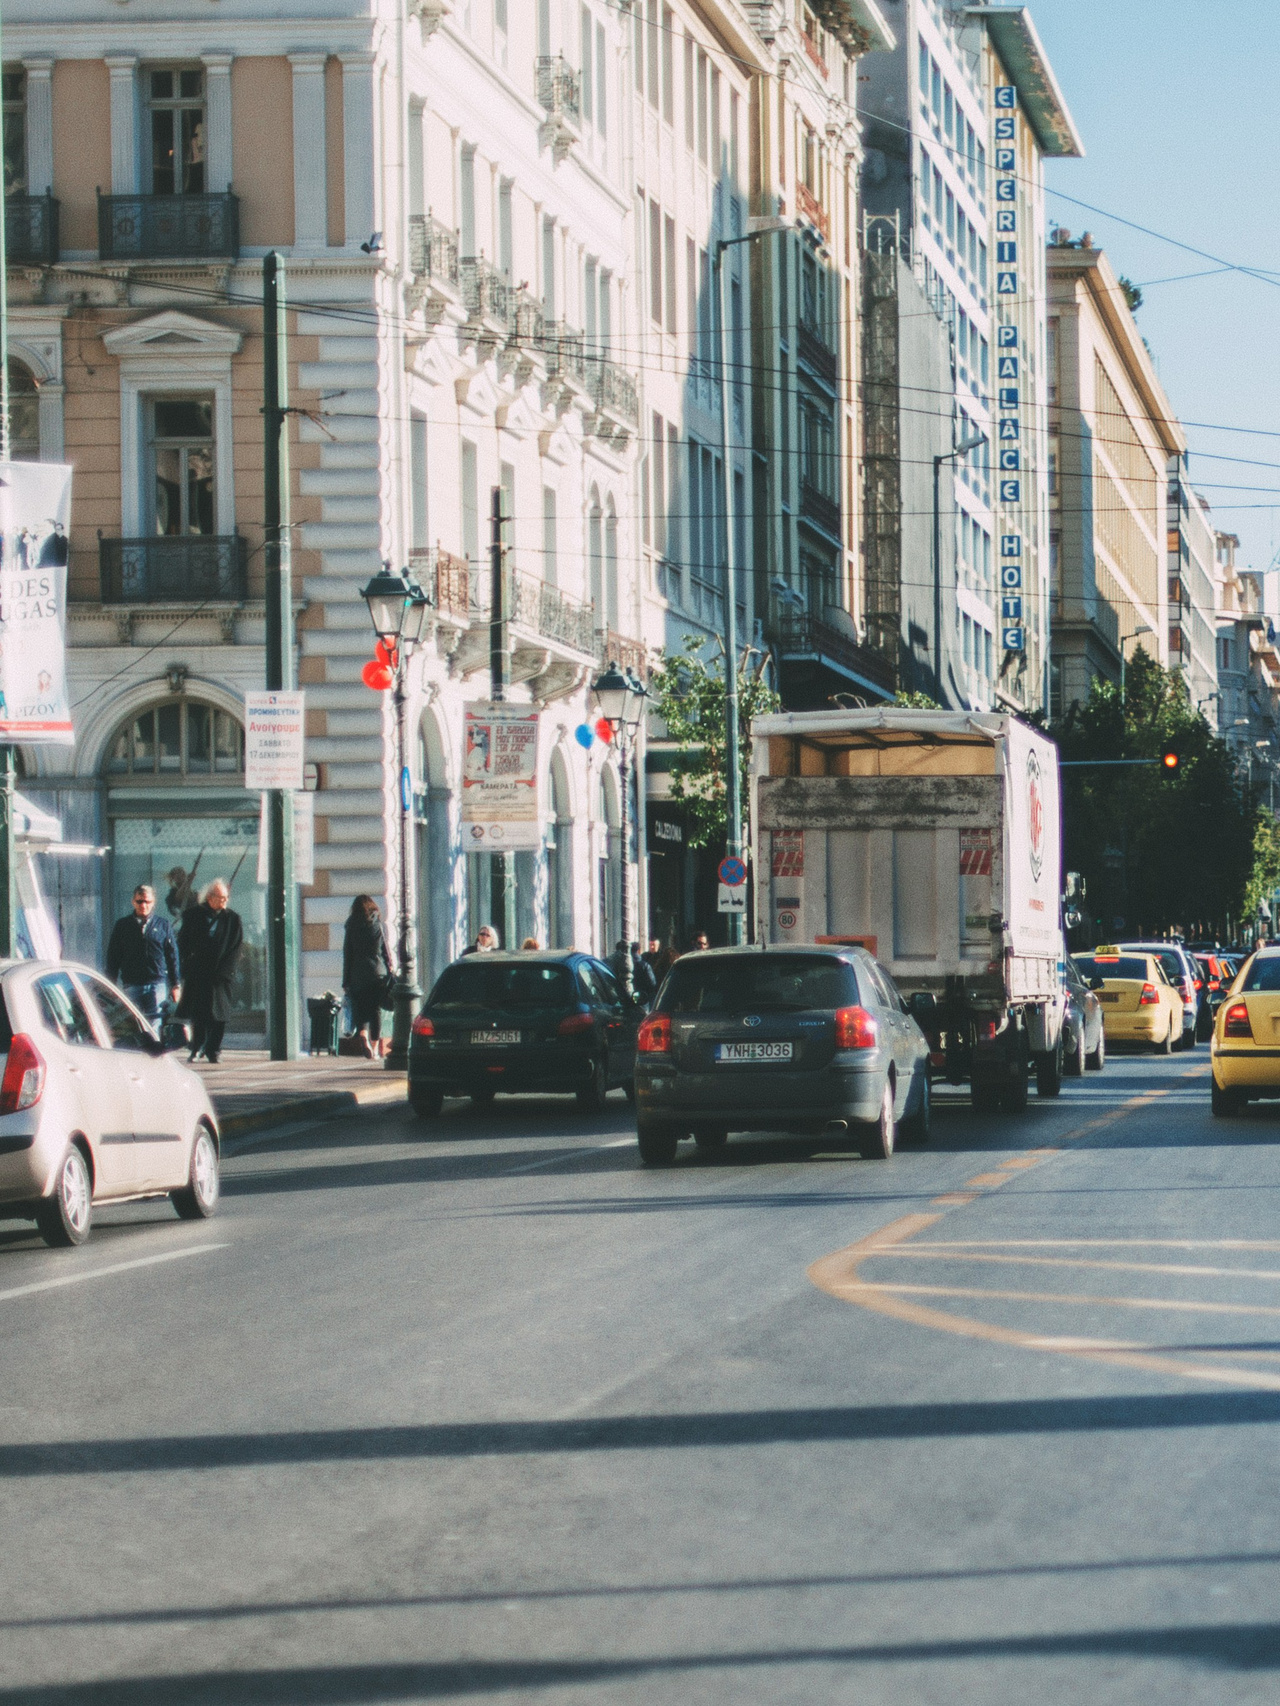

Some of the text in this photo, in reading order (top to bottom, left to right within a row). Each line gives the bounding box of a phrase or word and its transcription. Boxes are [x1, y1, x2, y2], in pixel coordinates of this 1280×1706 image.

[997, 88, 1016, 292] ESPERIA
[1000, 327, 1017, 500] PALACE
[249, 750, 258, 759] 17
[781, 915, 794, 925] 80
